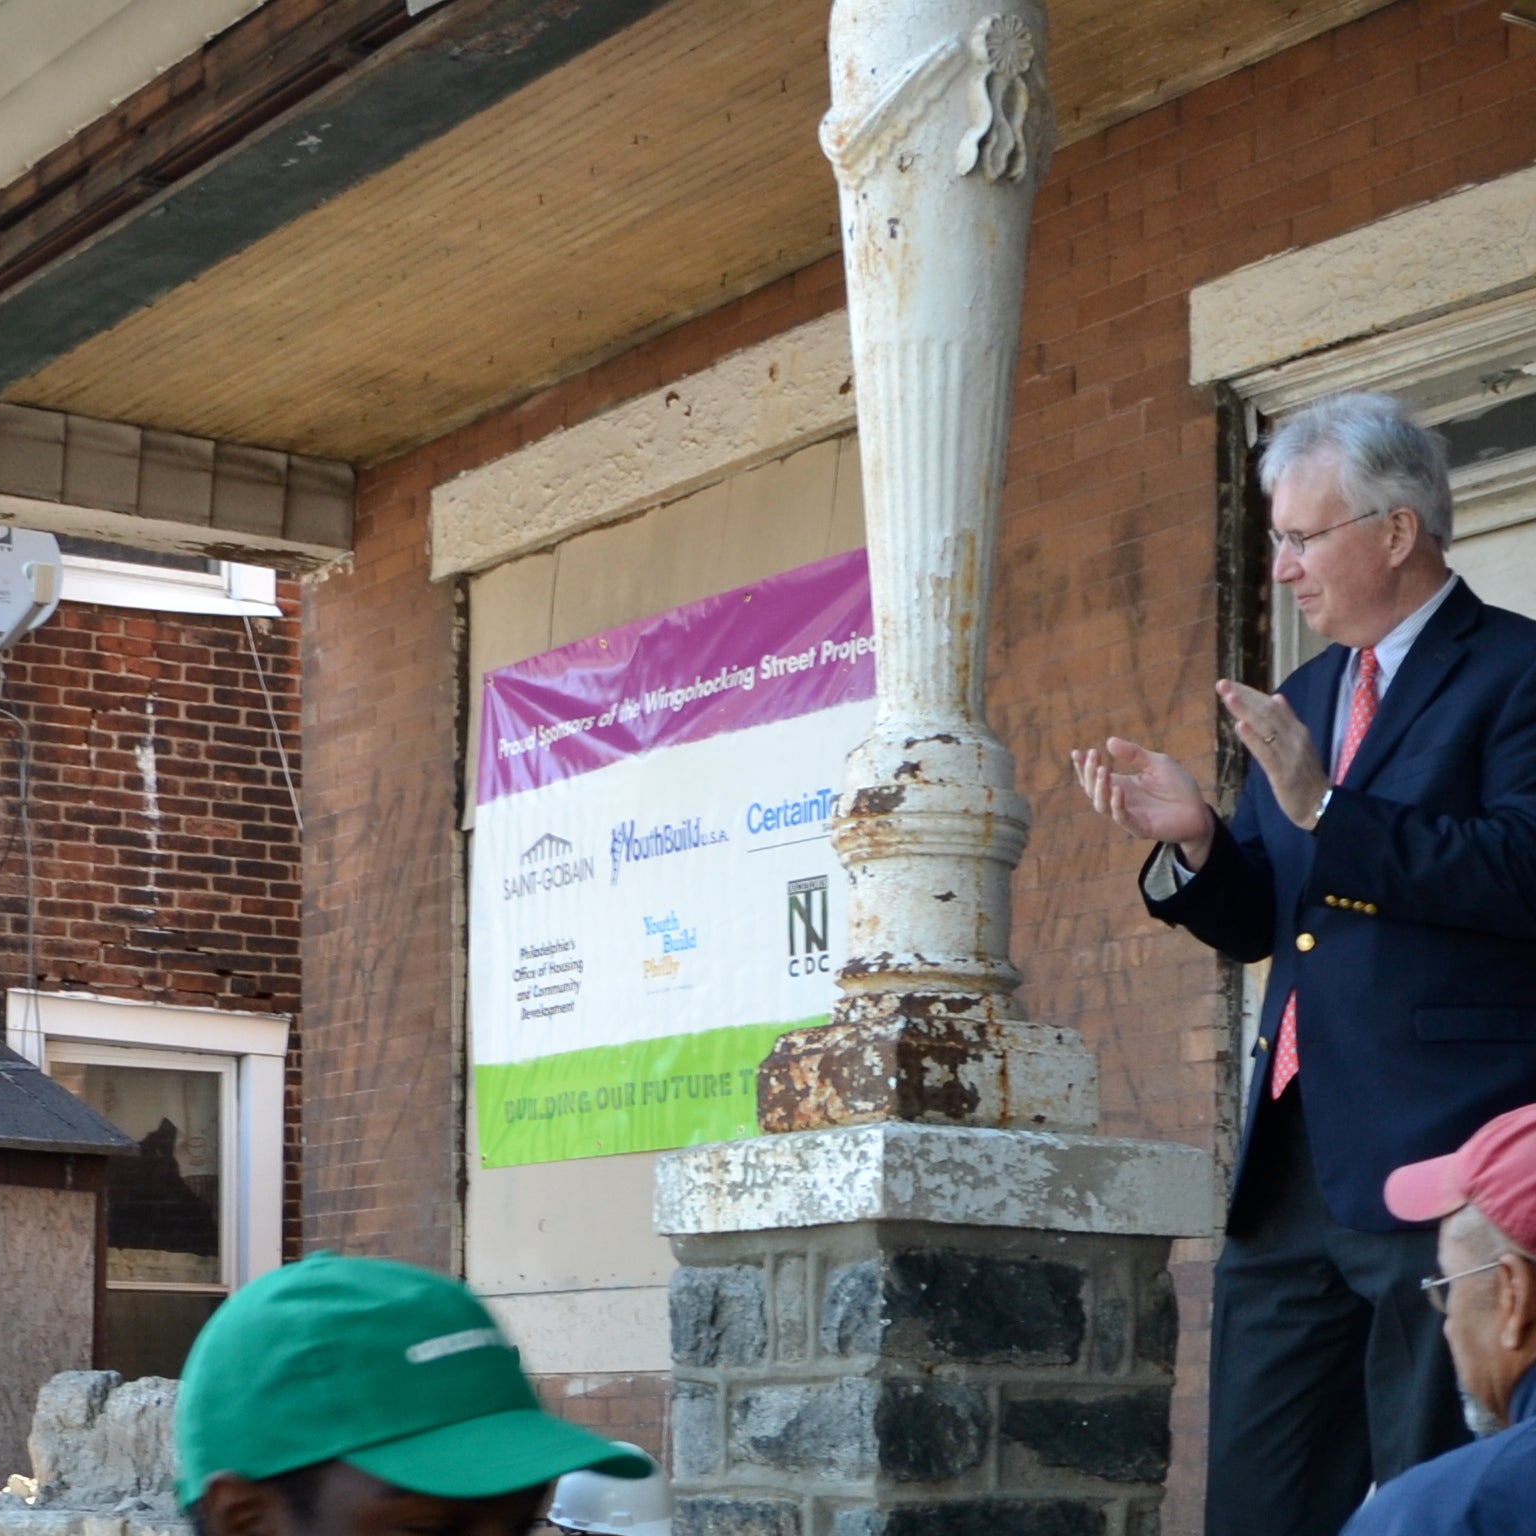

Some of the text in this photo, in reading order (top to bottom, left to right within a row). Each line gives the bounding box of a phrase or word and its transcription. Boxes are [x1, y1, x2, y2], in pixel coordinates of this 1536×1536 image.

[497, 727, 537, 760] Proud
[537, 715, 597, 751] Sponsors
[596, 702, 619, 728] of
[618, 696, 642, 723] the
[644, 664, 756, 714] Wingohocking
[760, 647, 816, 680] Street
[620, 816, 703, 862] YouthBuild
[502, 856, 596, 901] SAINT-GOBAIN
[643, 910, 680, 936] Youth
[663, 928, 697, 953] Build
[512, 959, 583, 982] Office of Housing
[643, 955, 680, 980] Philly
[515, 978, 581, 1002] and Community
[520, 1000, 575, 1021] Development
[504, 1088, 593, 1124] BUILDING
[595, 1081, 637, 1111] OUR
[641, 1071, 733, 1107] FUTURE
